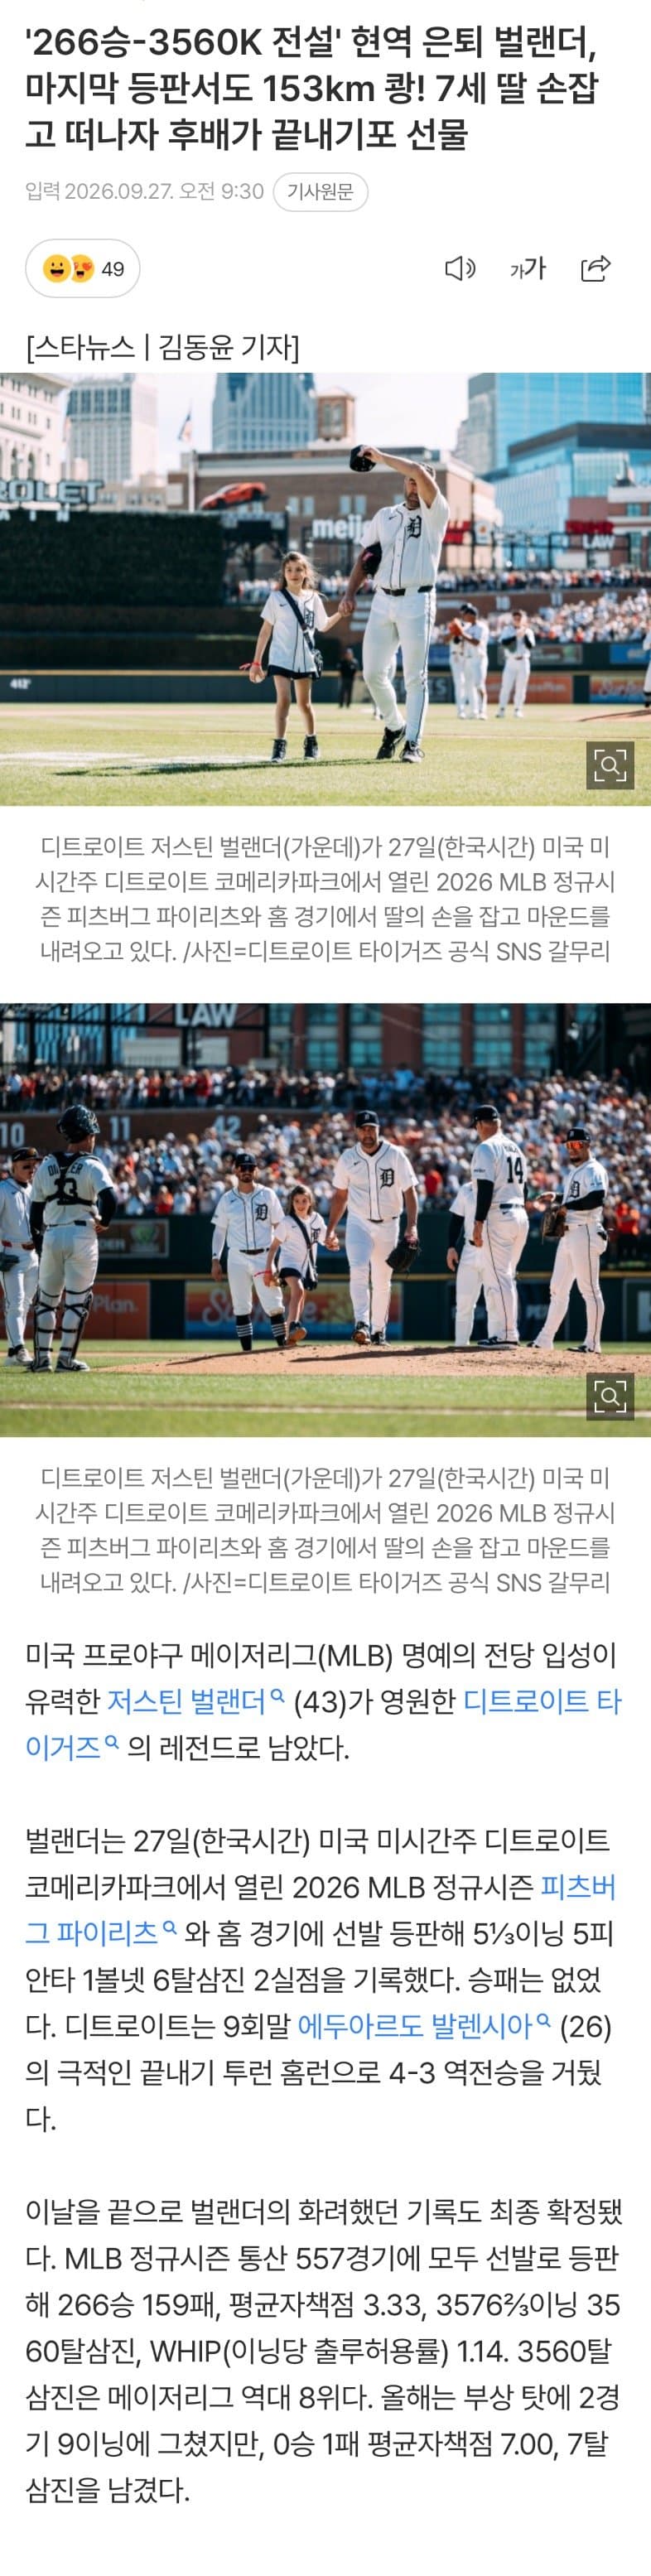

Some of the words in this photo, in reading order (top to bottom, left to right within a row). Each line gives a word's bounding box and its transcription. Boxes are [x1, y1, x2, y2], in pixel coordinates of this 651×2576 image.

[27, 26, 263, 58] '266승-3560K
[272, 25, 340, 58] 전설'
[351, 26, 411, 58] 현역
[422, 26, 481, 58] 은퇴
[496, 26, 596, 62] 벌랜더,
[27, 72, 119, 104] 마지막
[128, 72, 253, 104] 등판서도
[263, 75, 374, 102] 153km
[385, 72, 424, 104] 쾅!
[436, 72, 485, 104] 7세
[498, 72, 527, 104] 딸
[537, 72, 599, 104] 손잡
[26, 121, 55, 147] 고
[66, 118, 159, 151] 떠나자
[169, 118, 263, 151] 후배가
[272, 118, 397, 151] 끝내기포
[407, 118, 468, 151] 선물
[27, 181, 59, 200] 입력
[65, 183, 173, 199] 2026.09.27.
[180, 181, 214, 200] 오전
[222, 183, 263, 199] 9:30
[288, 183, 354, 200] 기사원문
[102, 262, 124, 277] 49
[27, 334, 135, 364] [스타뉴스
[159, 334, 234, 360] 김동윤
[242, 334, 298, 364] 기자]
[311, 514, 374, 540] meij
[582, 534, 615, 549] LAW
[42, 836, 144, 858] 디트로이트
[152, 836, 212, 858] 저스틴
[221, 836, 383, 861] 벌랜더(가운데)가
[389, 836, 534, 861] 27일(한국시간)
[543, 836, 583, 858] 미국
[591, 836, 608, 858] 미
[36, 871, 98, 893] 시간주
[106, 871, 209, 893] 디트로이트
[215, 871, 380, 893] 코메리카파크에서
[388, 871, 428, 893] 열린
[437, 873, 492, 891] 2026
[500, 873, 546, 891] MLB
[554, 871, 614, 893] 정규시
[41, 907, 61, 927] 즌
[68, 905, 151, 928] 피츠버그
[157, 905, 262, 928] 파이리츠와
[268, 905, 288, 928] 홈
[295, 905, 375, 928] 경기에서
[385, 905, 423, 928] 딸의
[432, 906, 473, 928] 손을
[480, 905, 520, 927] 잡고
[528, 905, 610, 928] 마운드를
[176, 1003, 239, 1026] LAW
[110, 1116, 131, 1141] 11
[506, 1156, 523, 1184] 14
[42, 1467, 145, 1489] 디트로이트
[152, 1467, 212, 1489] 저스틴
[221, 1467, 383, 1493] 벌랜더(가운데)가
[389, 1467, 534, 1492] 27일(한국시간)
[543, 1467, 583, 1489] 미국
[591, 1467, 608, 1489] 미
[41, 1571, 123, 1594] 내려오고
[131, 1571, 176, 1594] 있다.
[183, 1571, 352, 1594] /사진=디트로이트
[360, 1571, 442, 1594] 타이거즈
[449, 1571, 488, 1594] 공식
[497, 1574, 541, 1592] SNS
[549, 1571, 609, 1594] 갈무리
[27, 1643, 75, 1669] 미국
[83, 1642, 183, 1669] 프로야구
[191, 1642, 392, 1672] 메이저리그(MLB)
[403, 1642, 475, 1669] 명예의
[485, 1642, 535, 1668] 전당
[543, 1642, 615, 1669] 입성이
[26, 1688, 101, 1715] 유력한
[108, 1688, 181, 1715] 저스틴
[192, 1688, 263, 1715] 벌랜더
[295, 1688, 374, 1719] (43)가
[381, 1688, 456, 1715] 영원한
[465, 1688, 589, 1715] 디트로이트
[598, 1688, 622, 1715] 타
[27, 1734, 100, 1762] 이거즈
[128, 1735, 150, 1762] 의
[161, 1734, 260, 1762] 레전드로
[269, 1734, 349, 1762] 남았다.
[27, 1827, 126, 1855] 벌랜더는
[134, 1827, 309, 1858] 27일(한국시간)
[321, 1827, 369, 1855] 미국
[379, 1827, 477, 1855] 미시간주
[486, 1827, 610, 1855] 디트로이트
[25, 1922, 51, 1944] 그
[56, 1919, 158, 1948] 파이리츠
[185, 1919, 210, 1948] 와
[217, 1919, 243, 1947] 홈
[249, 1919, 324, 1948] 경기에
[332, 1920, 383, 1947] 선발
[389, 1919, 465, 1948] 등판해
[573, 1920, 613, 1947] 5피
[26, 2013, 56, 2041] 다.
[65, 2012, 216, 2041] 디트로이트는
[223, 2012, 292, 2040] 9회말
[298, 2012, 425, 2041] 에두아르도
[432, 2012, 533, 2041] 발렌시아
[561, 2014, 611, 2043] (26)
[27, 2198, 100, 2226] 이날을
[108, 2200, 183, 2225] 끝으로
[192, 2198, 289, 2226] 벌랜더의
[298, 2198, 398, 2226] 화려했던
[407, 2198, 482, 2226] 기록도
[490, 2198, 540, 2226] 최종
[547, 2198, 622, 2226] 확정됐
[26, 2292, 48, 2318] 해
[59, 2292, 134, 2318] 266승
[143, 2292, 220, 2322] 159패,
[229, 2291, 353, 2318] 평균자책점
[364, 2294, 426, 2322] 3.33,
[587, 2294, 620, 2316] 35
[26, 2385, 100, 2410] 삼진은
[108, 2384, 234, 2411] 메이저리그
[242, 2384, 290, 2411] 역대
[300, 2385, 373, 2411] 8위다.
[381, 2384, 456, 2411] 올해는
[464, 2385, 514, 2411] 부상
[523, 2384, 570, 2411] 탓에
[580, 2385, 618, 2410] 2경
[27, 2430, 48, 2458] 기
[58, 2430, 149, 2458] 9이닝에
[158, 2430, 264, 2461] 그쳤지만,
[274, 2431, 315, 2457] 0승
[323, 2431, 358, 2458] 1패
[368, 2430, 491, 2458] 평균자책점
[501, 2433, 558, 2461] 7.00,
[568, 2430, 609, 2457] 7탈
[26, 2477, 100, 2503] 삼진을
[109, 2477, 189, 2504] 남겼다.
